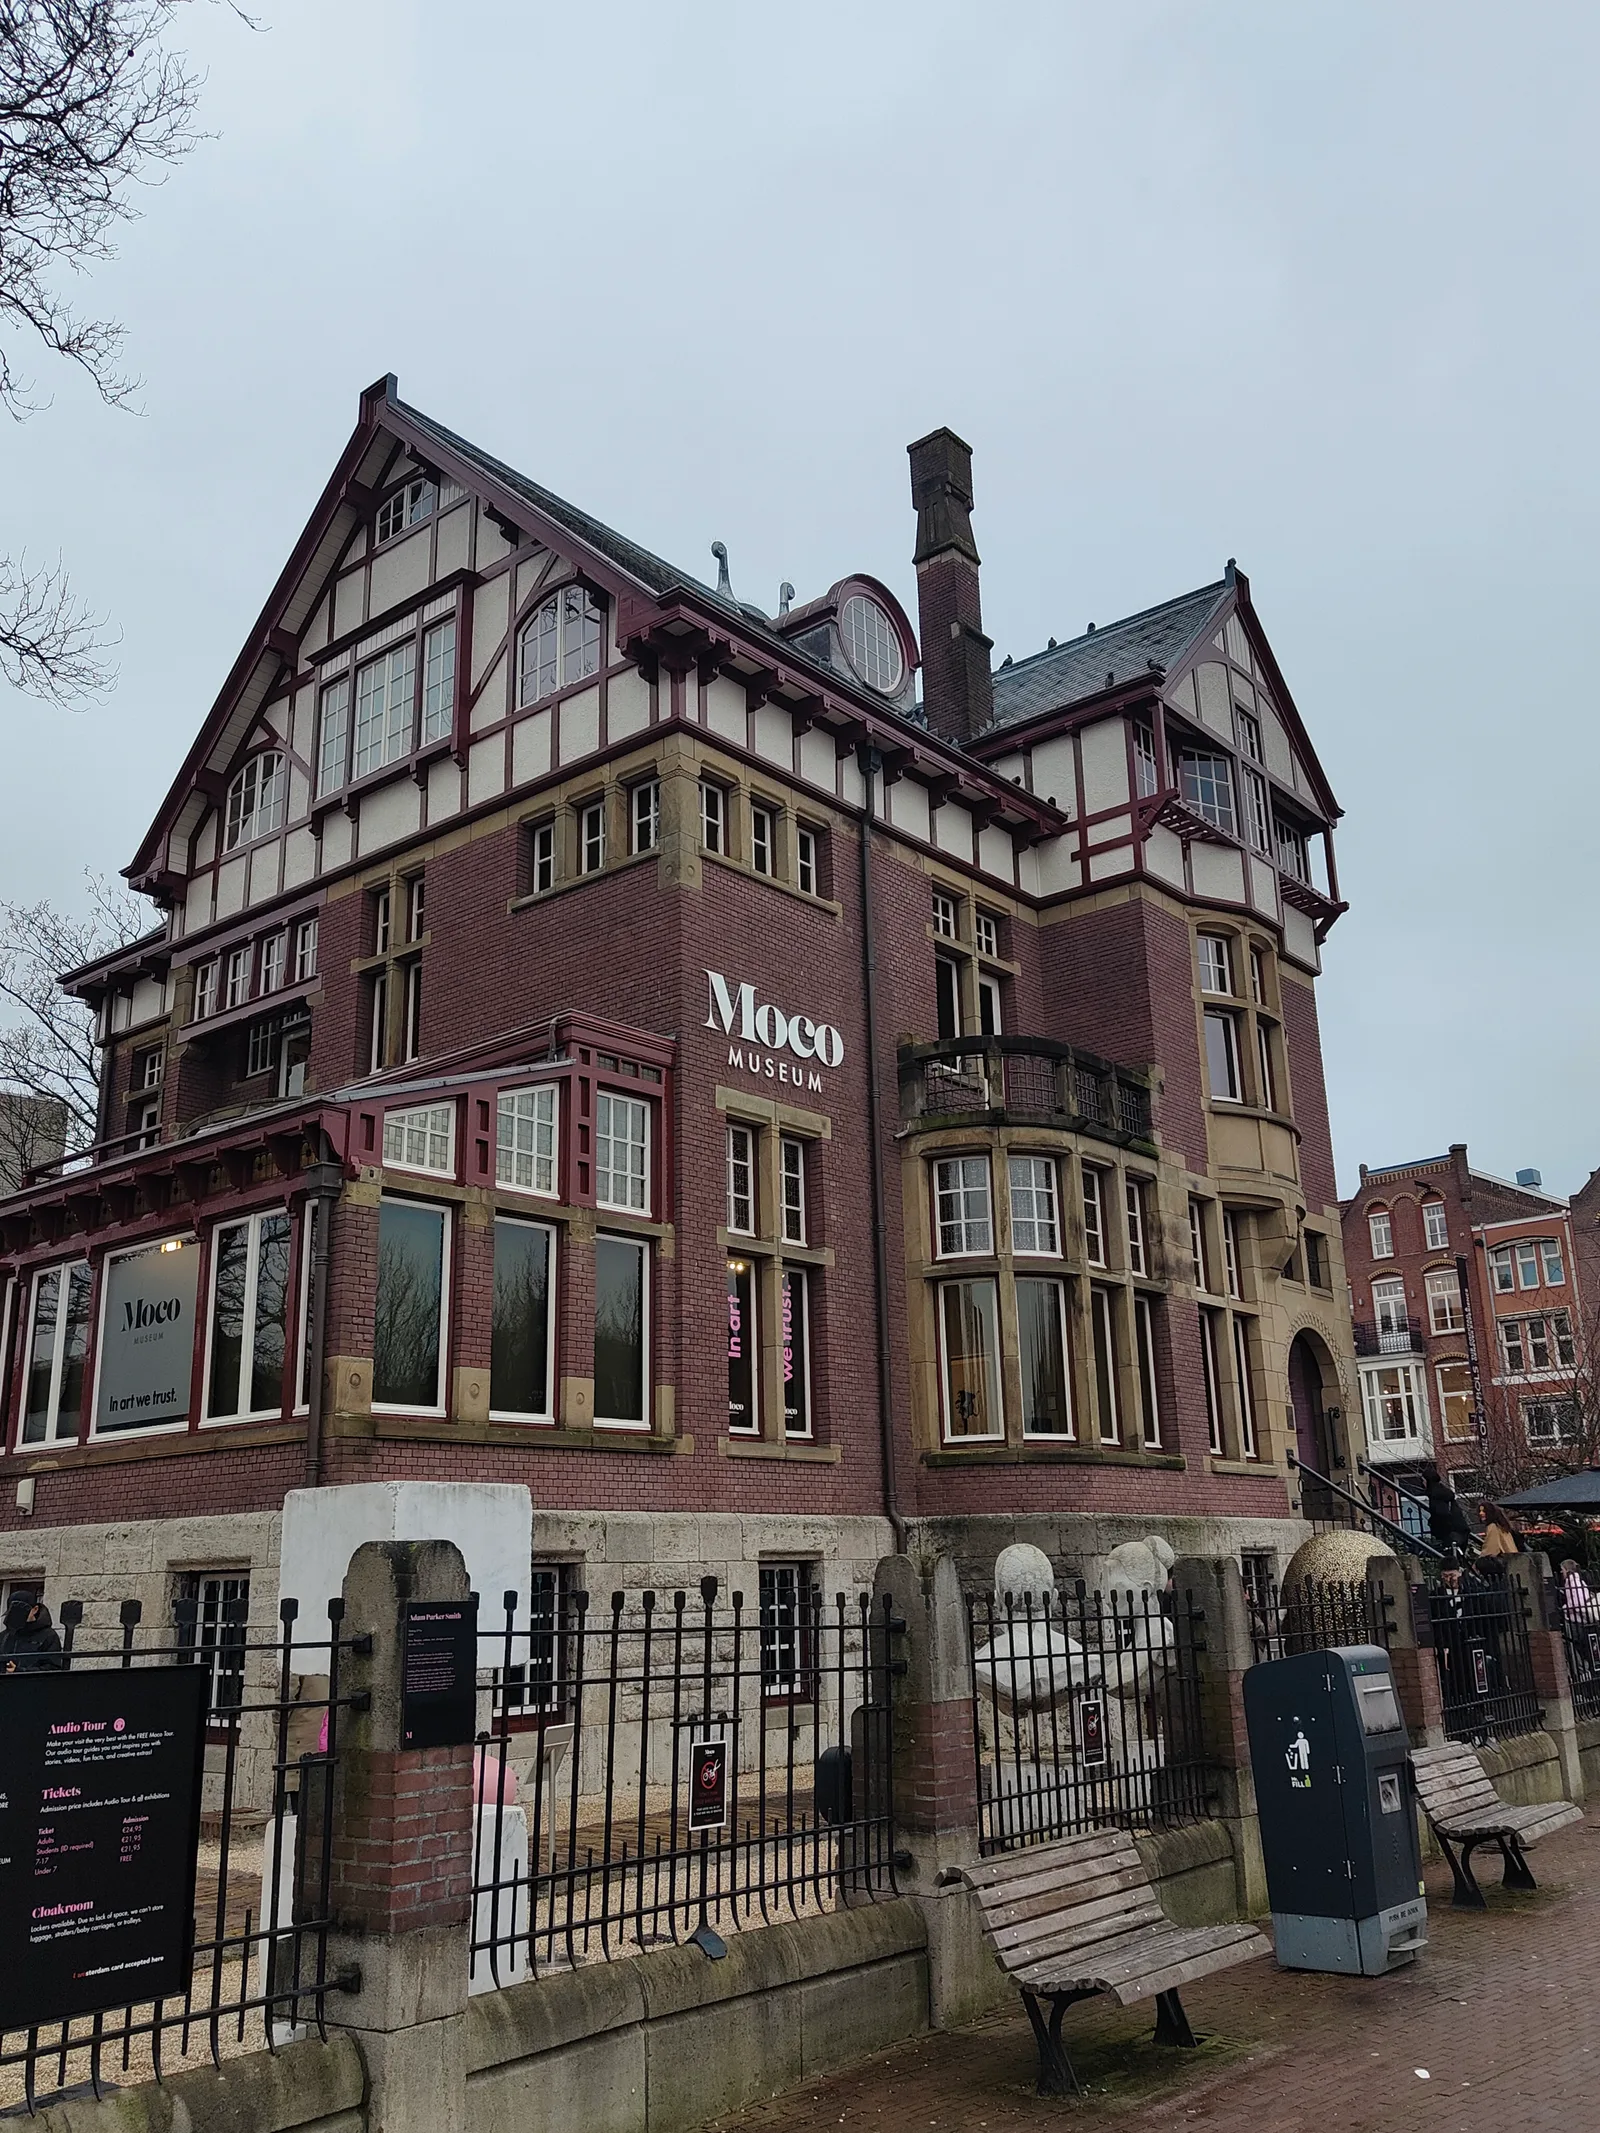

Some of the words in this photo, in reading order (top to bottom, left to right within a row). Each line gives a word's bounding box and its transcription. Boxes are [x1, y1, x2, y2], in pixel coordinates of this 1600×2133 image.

[701, 967, 844, 1068] Moco
[728, 1045, 822, 1093] MUSEUM
[121, 1297, 181, 1332] Moco
[727, 1294, 740, 1331] art
[133, 1332, 164, 1345] MUSEUM
[727, 1337, 741, 1358] In
[783, 1347, 793, 1383] we
[109, 1395, 118, 1412] In
[120, 1393, 135, 1411] art
[136, 1396, 151, 1408] we
[152, 1387, 177, 1406] trust.
[785, 1407, 798, 1415] oco
[48, 1722, 80, 1734] Audio
[82, 1721, 107, 1732] Tour
[46, 1740, 61, 1748] Make
[57, 1748, 72, 1756] audio
[83, 1746, 101, 1754] guides
[122, 1742, 140, 1750] inspires
[44, 1758, 63, 1766] stories,
[64, 1756, 82, 1764] videos,
[41, 1786, 81, 1800] Tickets
[40, 1805, 67, 1813] Admission
[68, 1802, 81, 1811] price
[82, 1800, 103, 1808] includes
[104, 1798, 120, 1806] Audio
[144, 1792, 170, 1801] exhibitions
[122, 1815, 149, 1824] Admission
[38, 1827, 54, 1835] Ticket
[36, 1837, 55, 1845] Adults
[36, 1847, 59, 1855] Students
[60, 1845, 69, 1853] (ID
[69, 1841, 94, 1851] required)
[120, 1854, 133, 1862] FREE
[32, 1900, 94, 1919] Cloakroom
[31, 1924, 50, 1933] Lockers
[51, 1920, 76, 1929] available.
[77, 1917, 89, 1925] Due
[113, 1911, 129, 1919] space,
[30, 1933, 53, 1943] luggage,
[91, 1922, 116, 1932] carriages,
[111, 1962, 124, 1971] card
[124, 1957, 150, 1969] accepted
[151, 1955, 164, 1964] here
